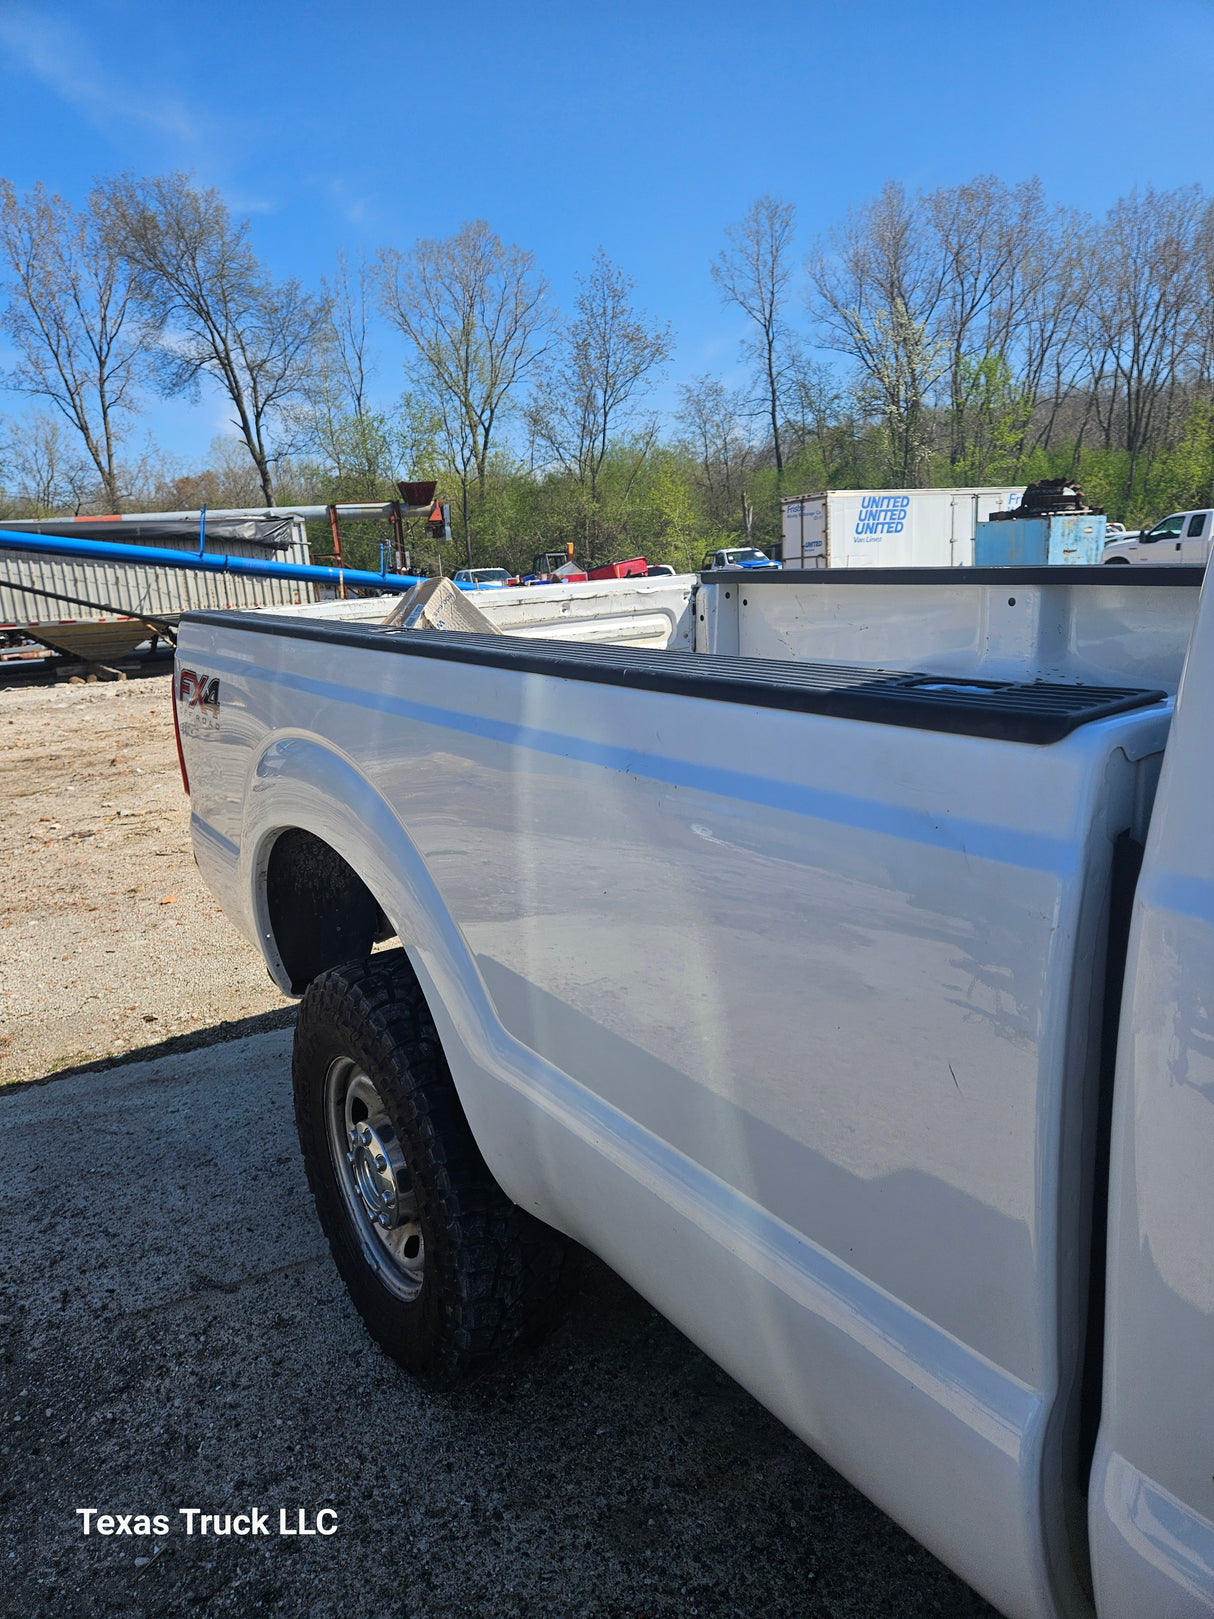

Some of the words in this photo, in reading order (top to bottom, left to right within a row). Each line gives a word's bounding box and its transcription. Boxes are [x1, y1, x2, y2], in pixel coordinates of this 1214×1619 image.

[861, 496, 910, 509] UNITED
[858, 509, 907, 522] UNITED
[855, 521, 904, 535] UNITED
[180, 668, 220, 720] FX4
